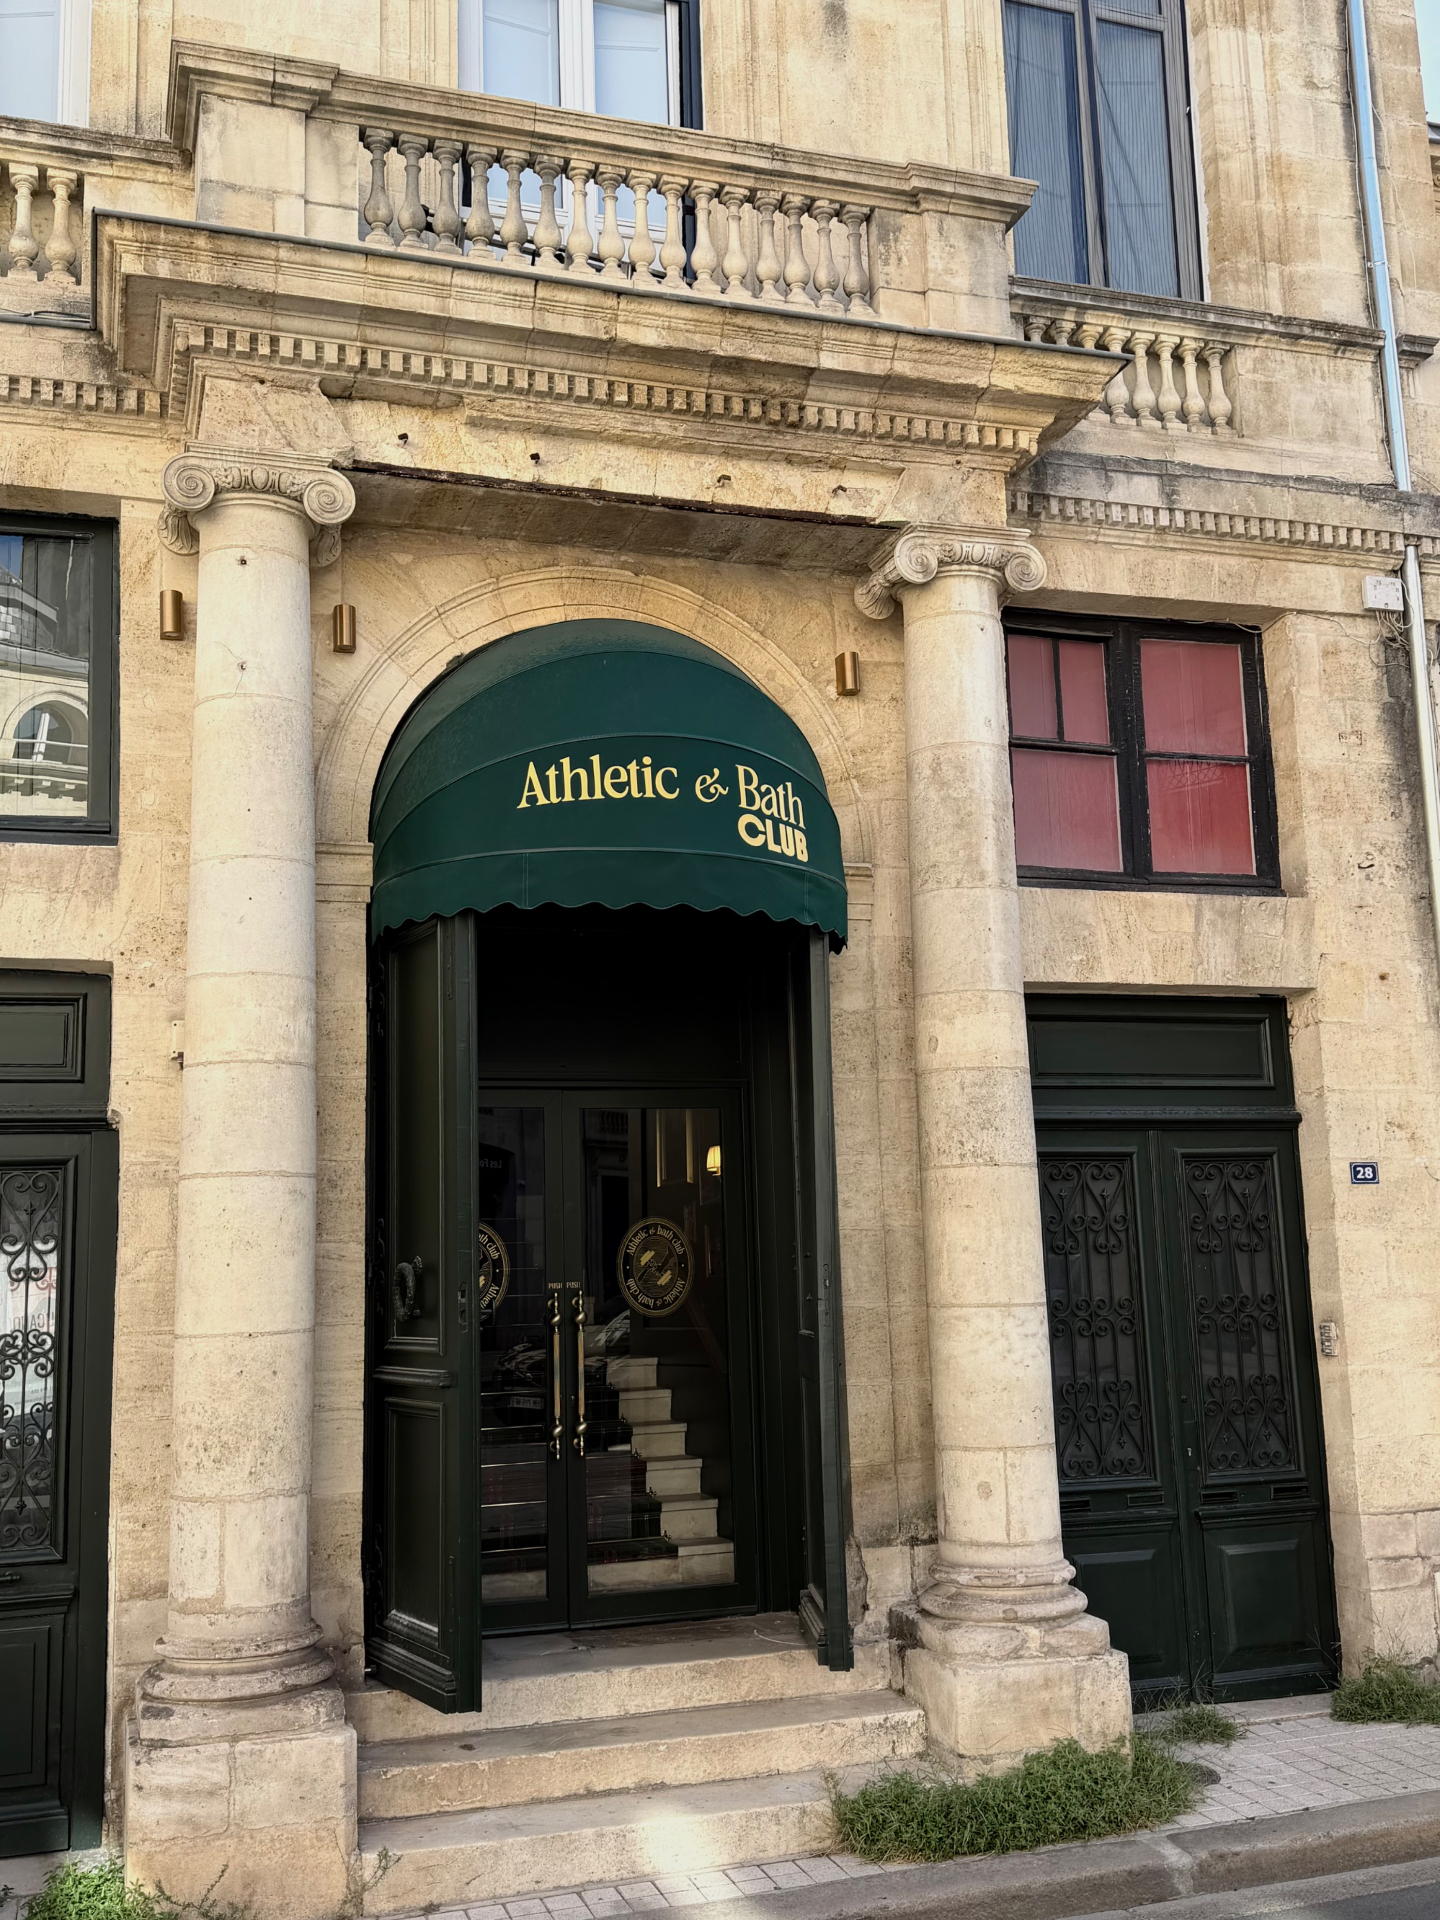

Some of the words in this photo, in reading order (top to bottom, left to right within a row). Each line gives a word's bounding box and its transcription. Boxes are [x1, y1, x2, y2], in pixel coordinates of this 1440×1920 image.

[516, 753, 680, 809] Athletic
[694, 767, 730, 803] &
[735, 764, 807, 829] Bath
[737, 813, 809, 863] CLUB
[1356, 1167, 1374, 1179] 28
[626, 1229, 649, 1257] Athletic
[656, 1225, 674, 1241] bath
[671, 1238, 686, 1255] club
[548, 1282, 563, 1290] PUSH
[566, 1281, 581, 1289] PUSH
[664, 1277, 686, 1304] Athletic
